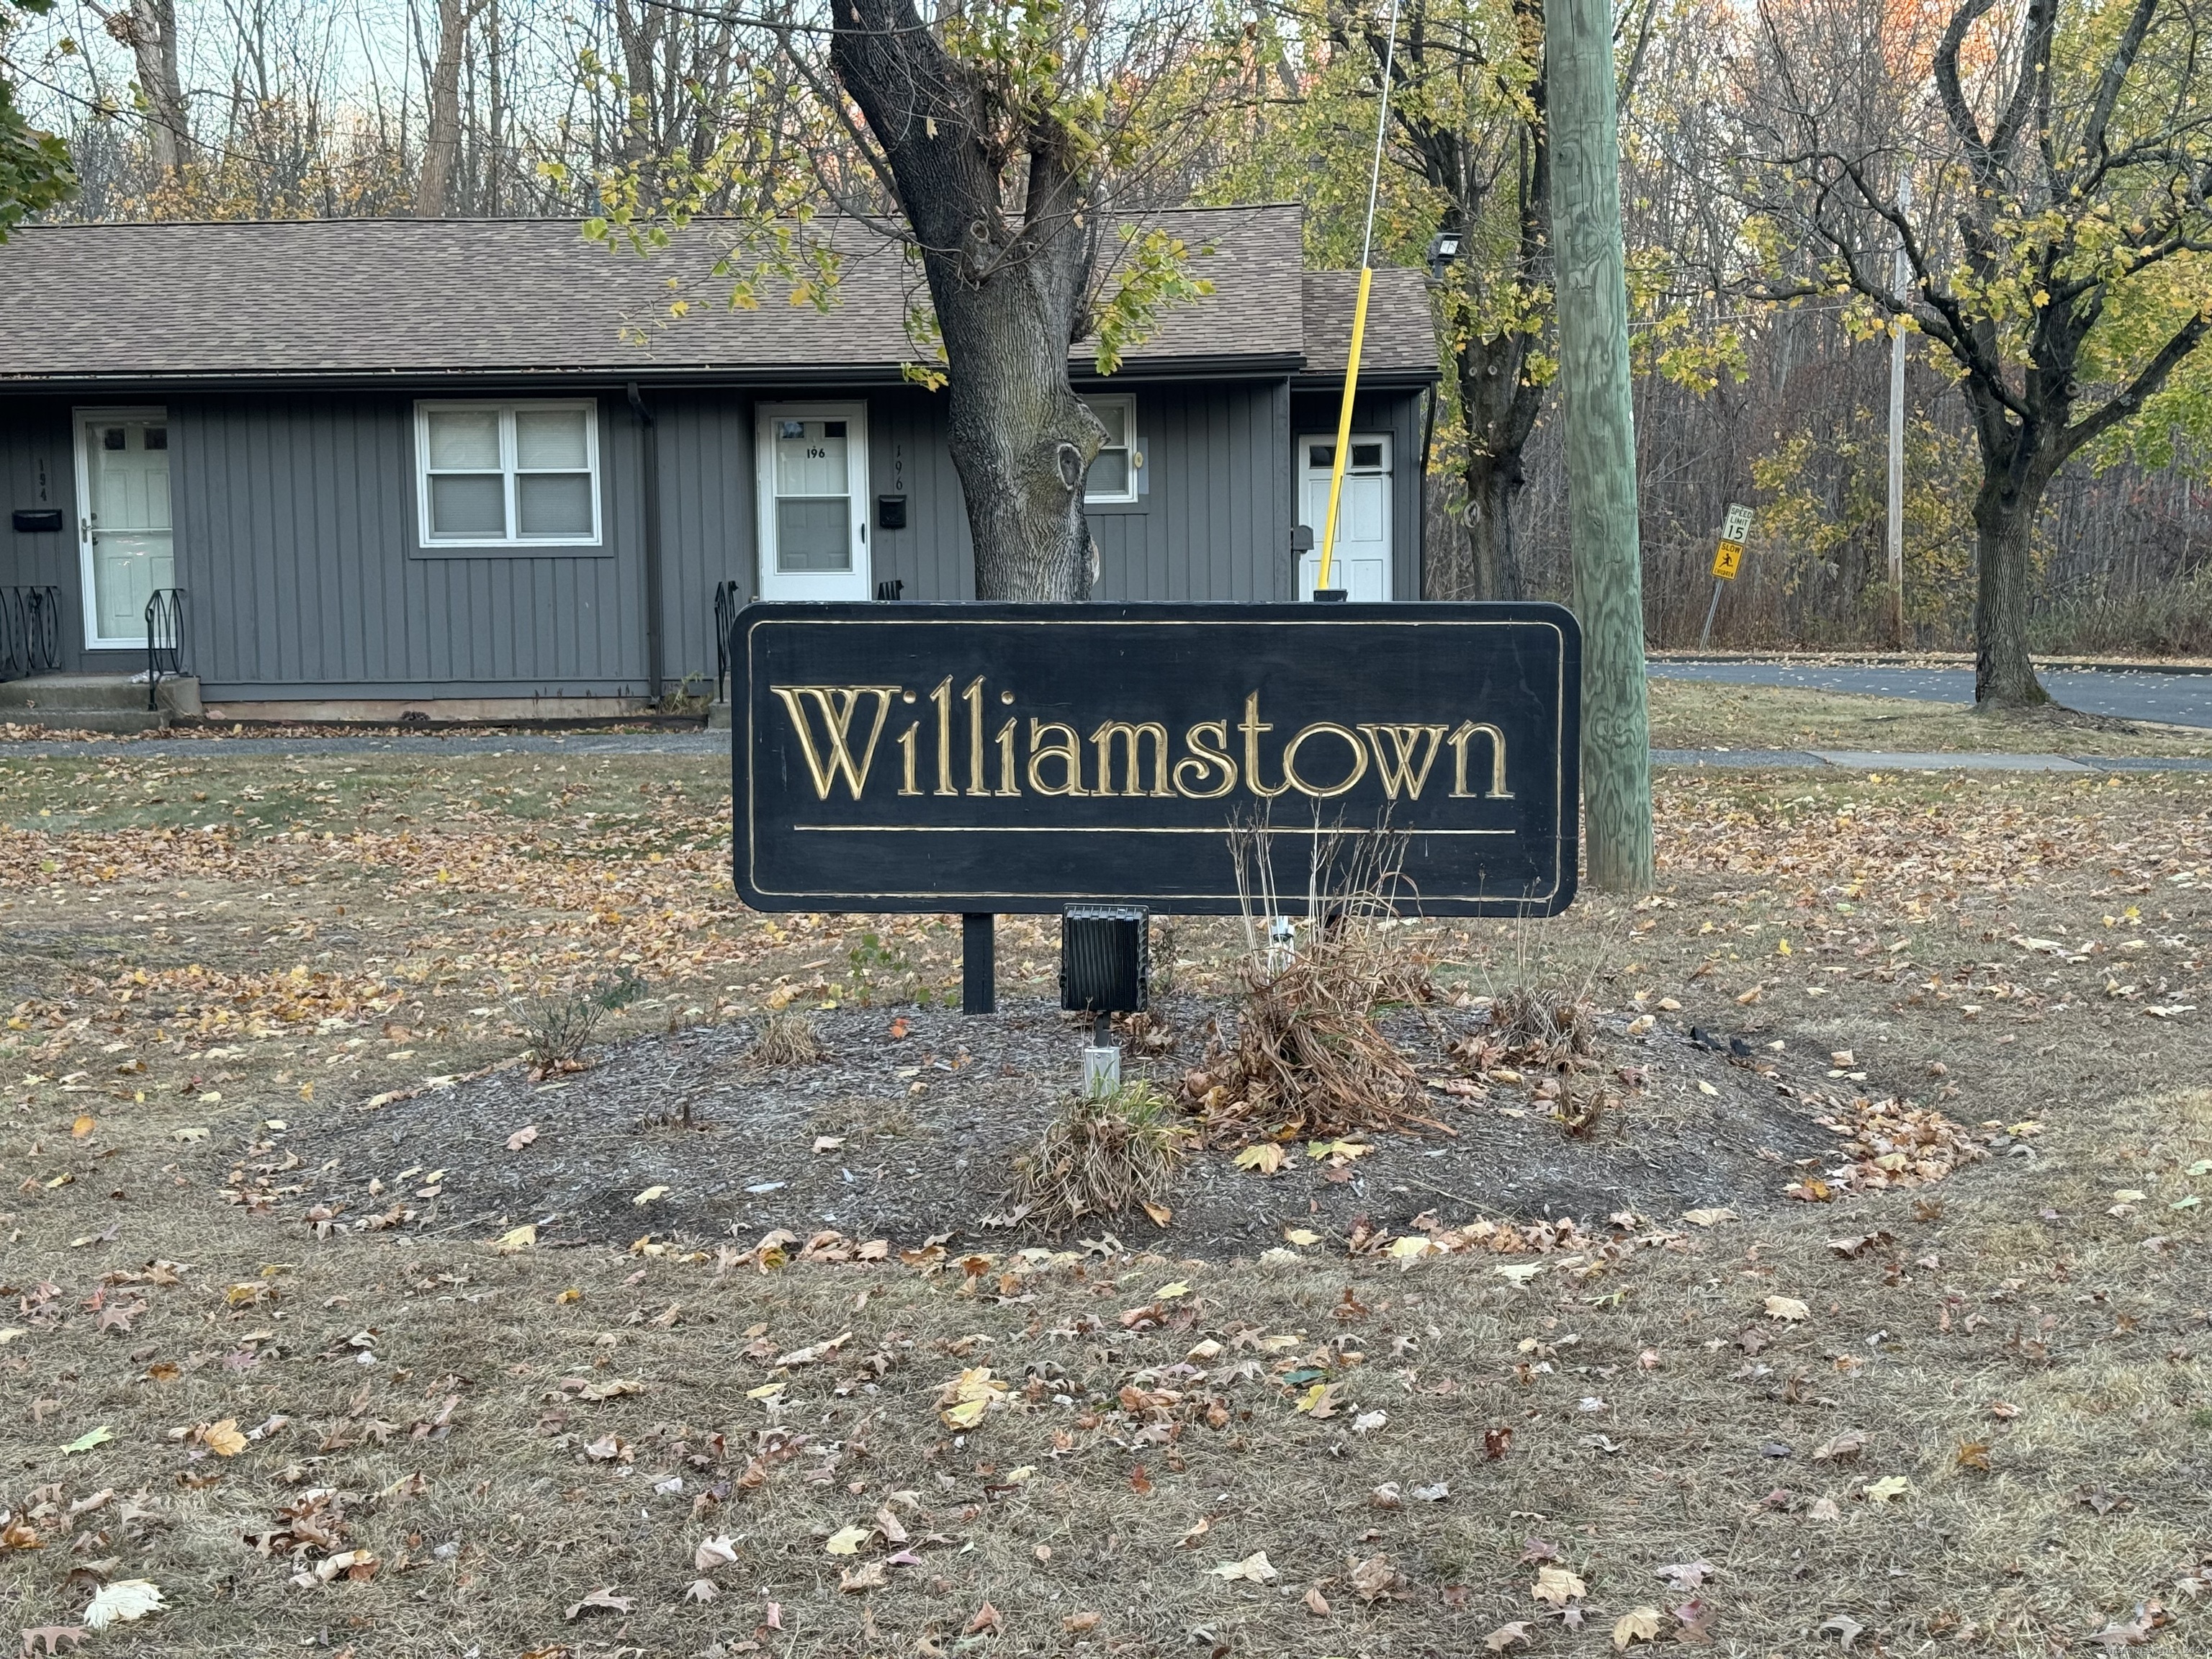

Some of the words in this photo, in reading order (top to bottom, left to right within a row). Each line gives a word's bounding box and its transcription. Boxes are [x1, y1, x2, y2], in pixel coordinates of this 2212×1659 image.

[806, 448, 825, 459] 196
[894, 444, 903, 490] 196
[1731, 508, 1752, 518] SPEED
[1730, 516, 1748, 526] LIMIT
[1728, 525, 1745, 539] 15
[1721, 544, 1741, 554] SLOW
[769, 675, 1516, 801] Williamstown
